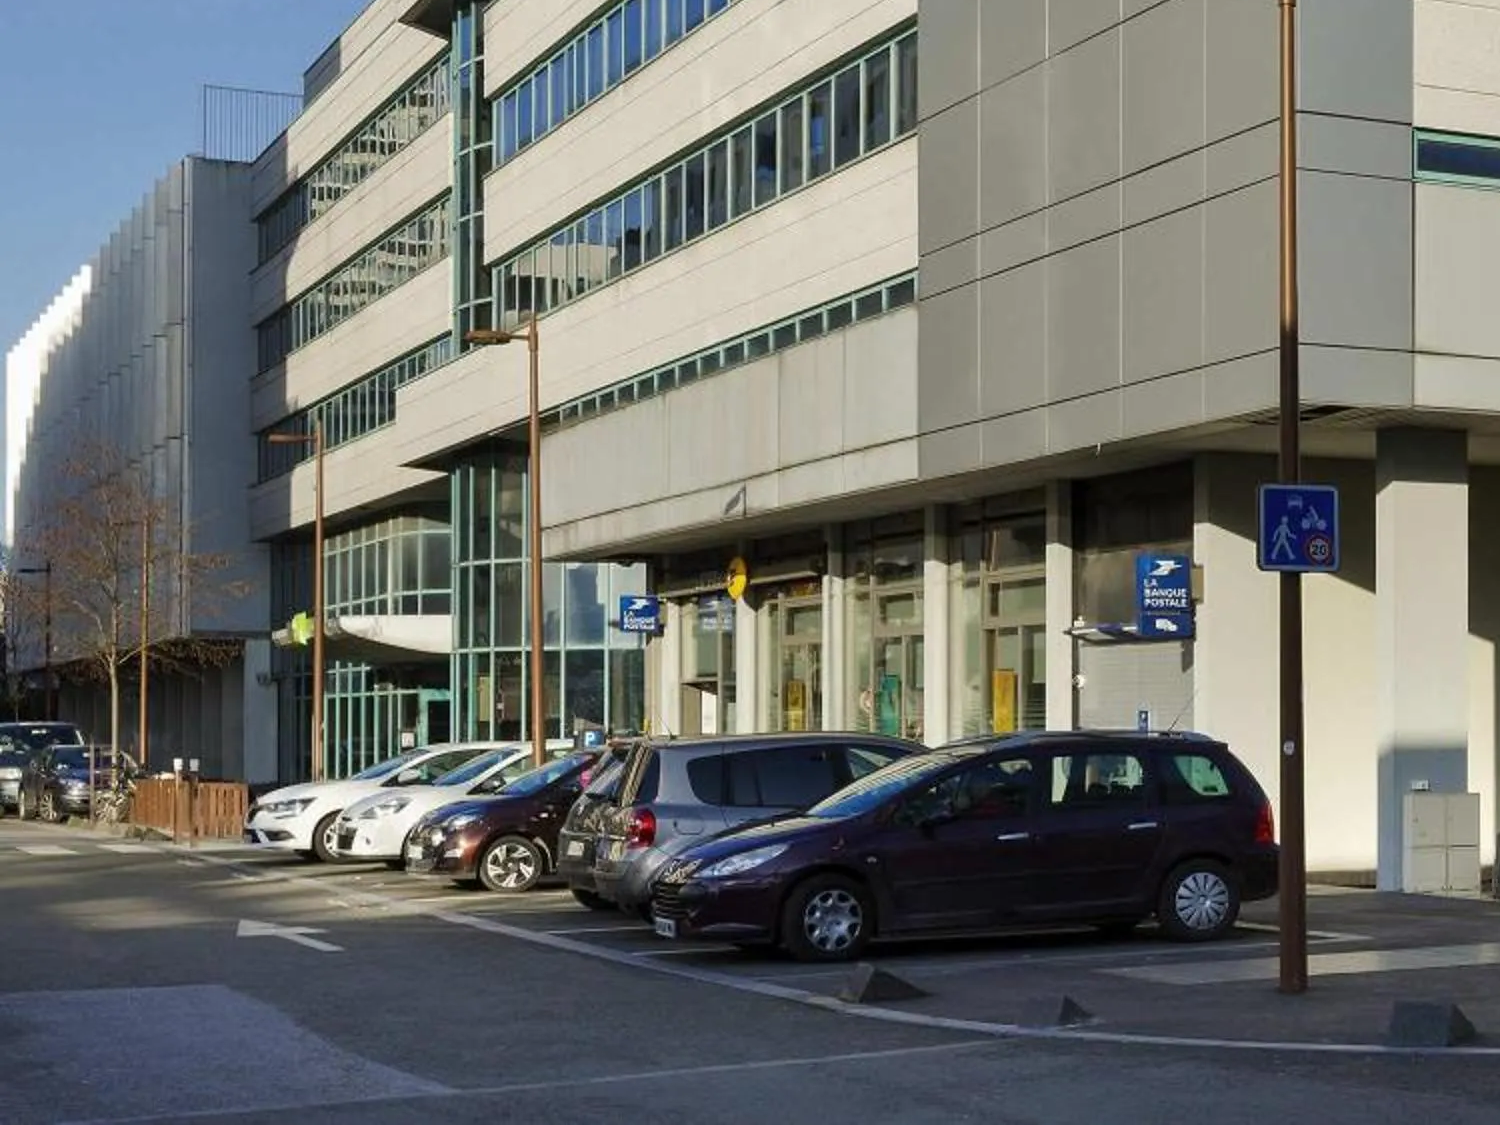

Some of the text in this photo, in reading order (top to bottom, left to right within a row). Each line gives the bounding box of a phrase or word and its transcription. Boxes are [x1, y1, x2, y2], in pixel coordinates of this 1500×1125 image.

[1144, 578, 1158, 587] LA
[1144, 588, 1187, 597] BANQUE
[1144, 598, 1188, 608] POSTALE
